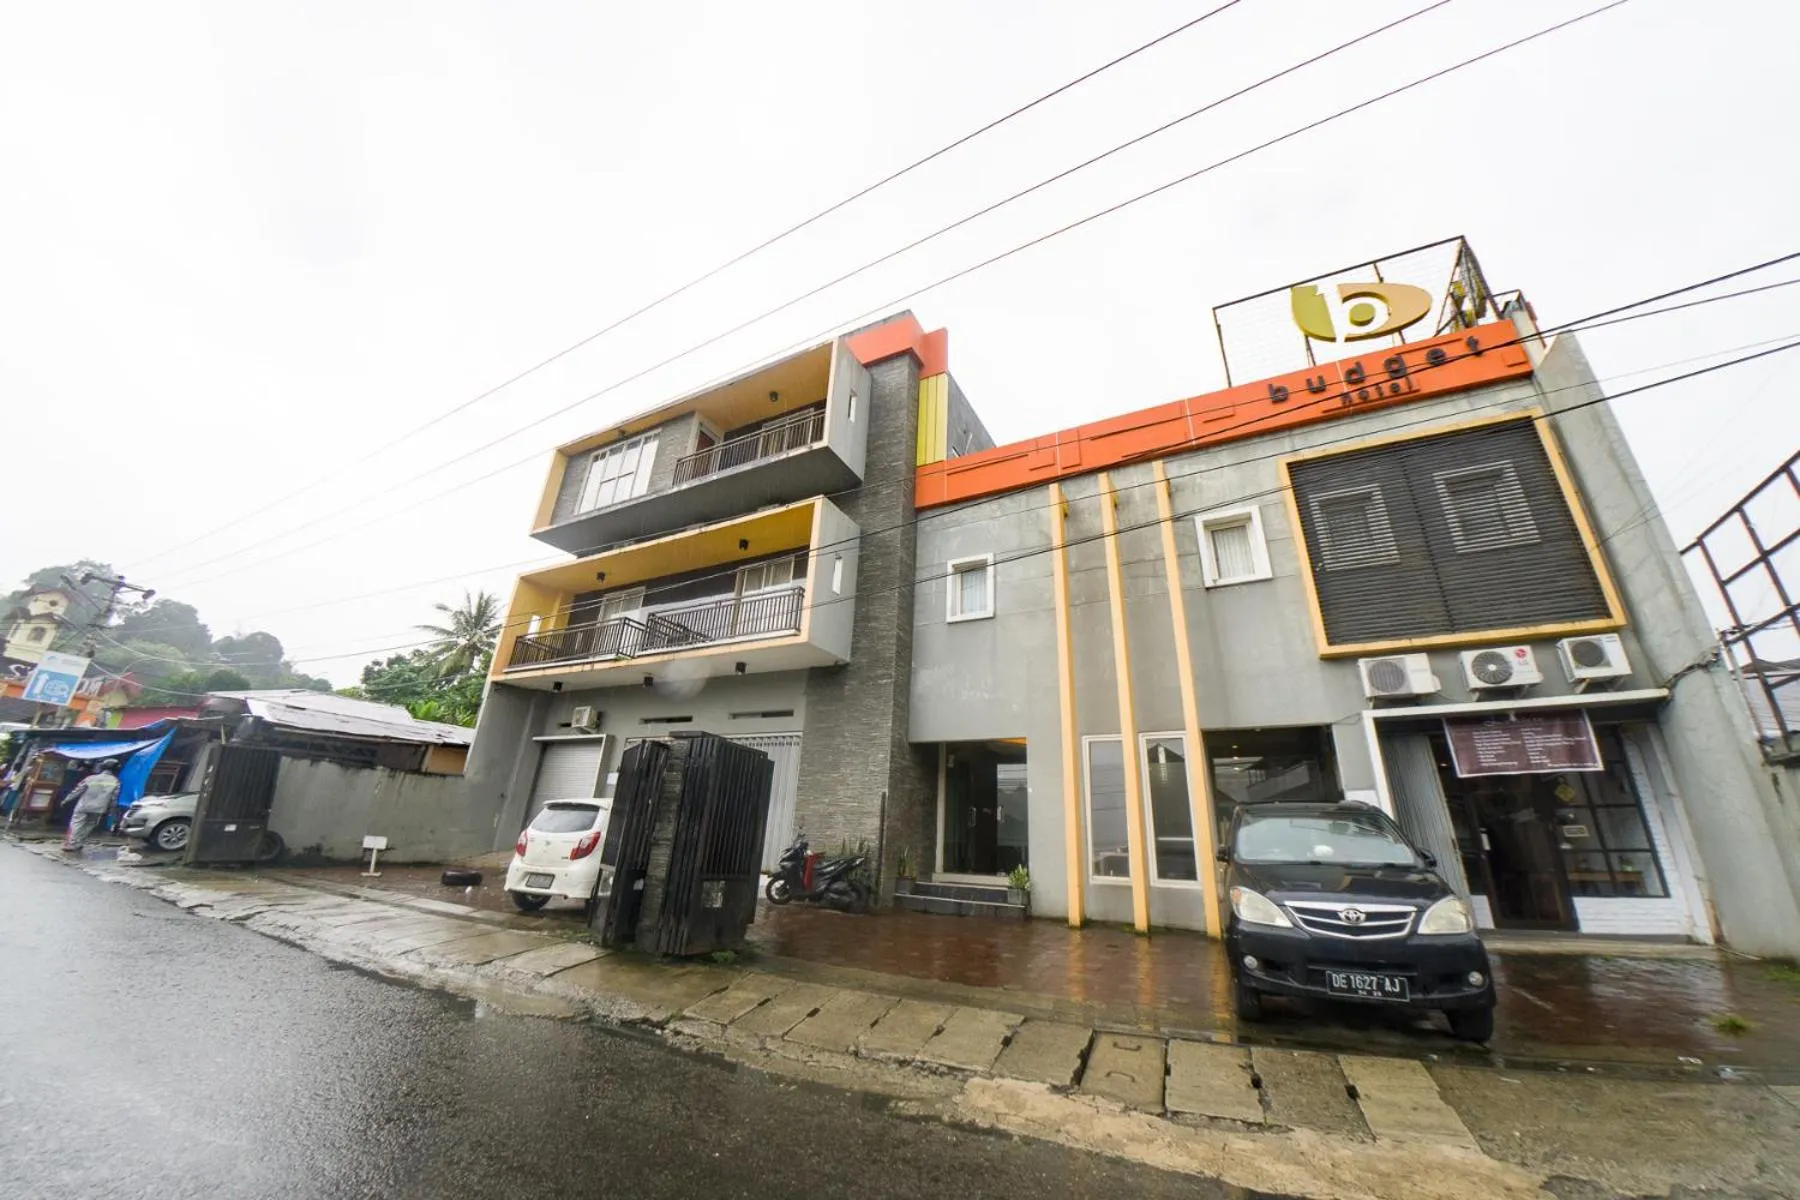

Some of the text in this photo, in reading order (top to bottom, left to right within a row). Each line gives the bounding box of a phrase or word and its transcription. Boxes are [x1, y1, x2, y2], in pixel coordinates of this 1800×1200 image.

[1267, 335, 1481, 403] budget
[1340, 375, 1413, 406] hotel
[1332, 973, 1348, 989] DE
[1350, 975, 1377, 990] 1627
[1384, 977, 1400, 993] AJ
